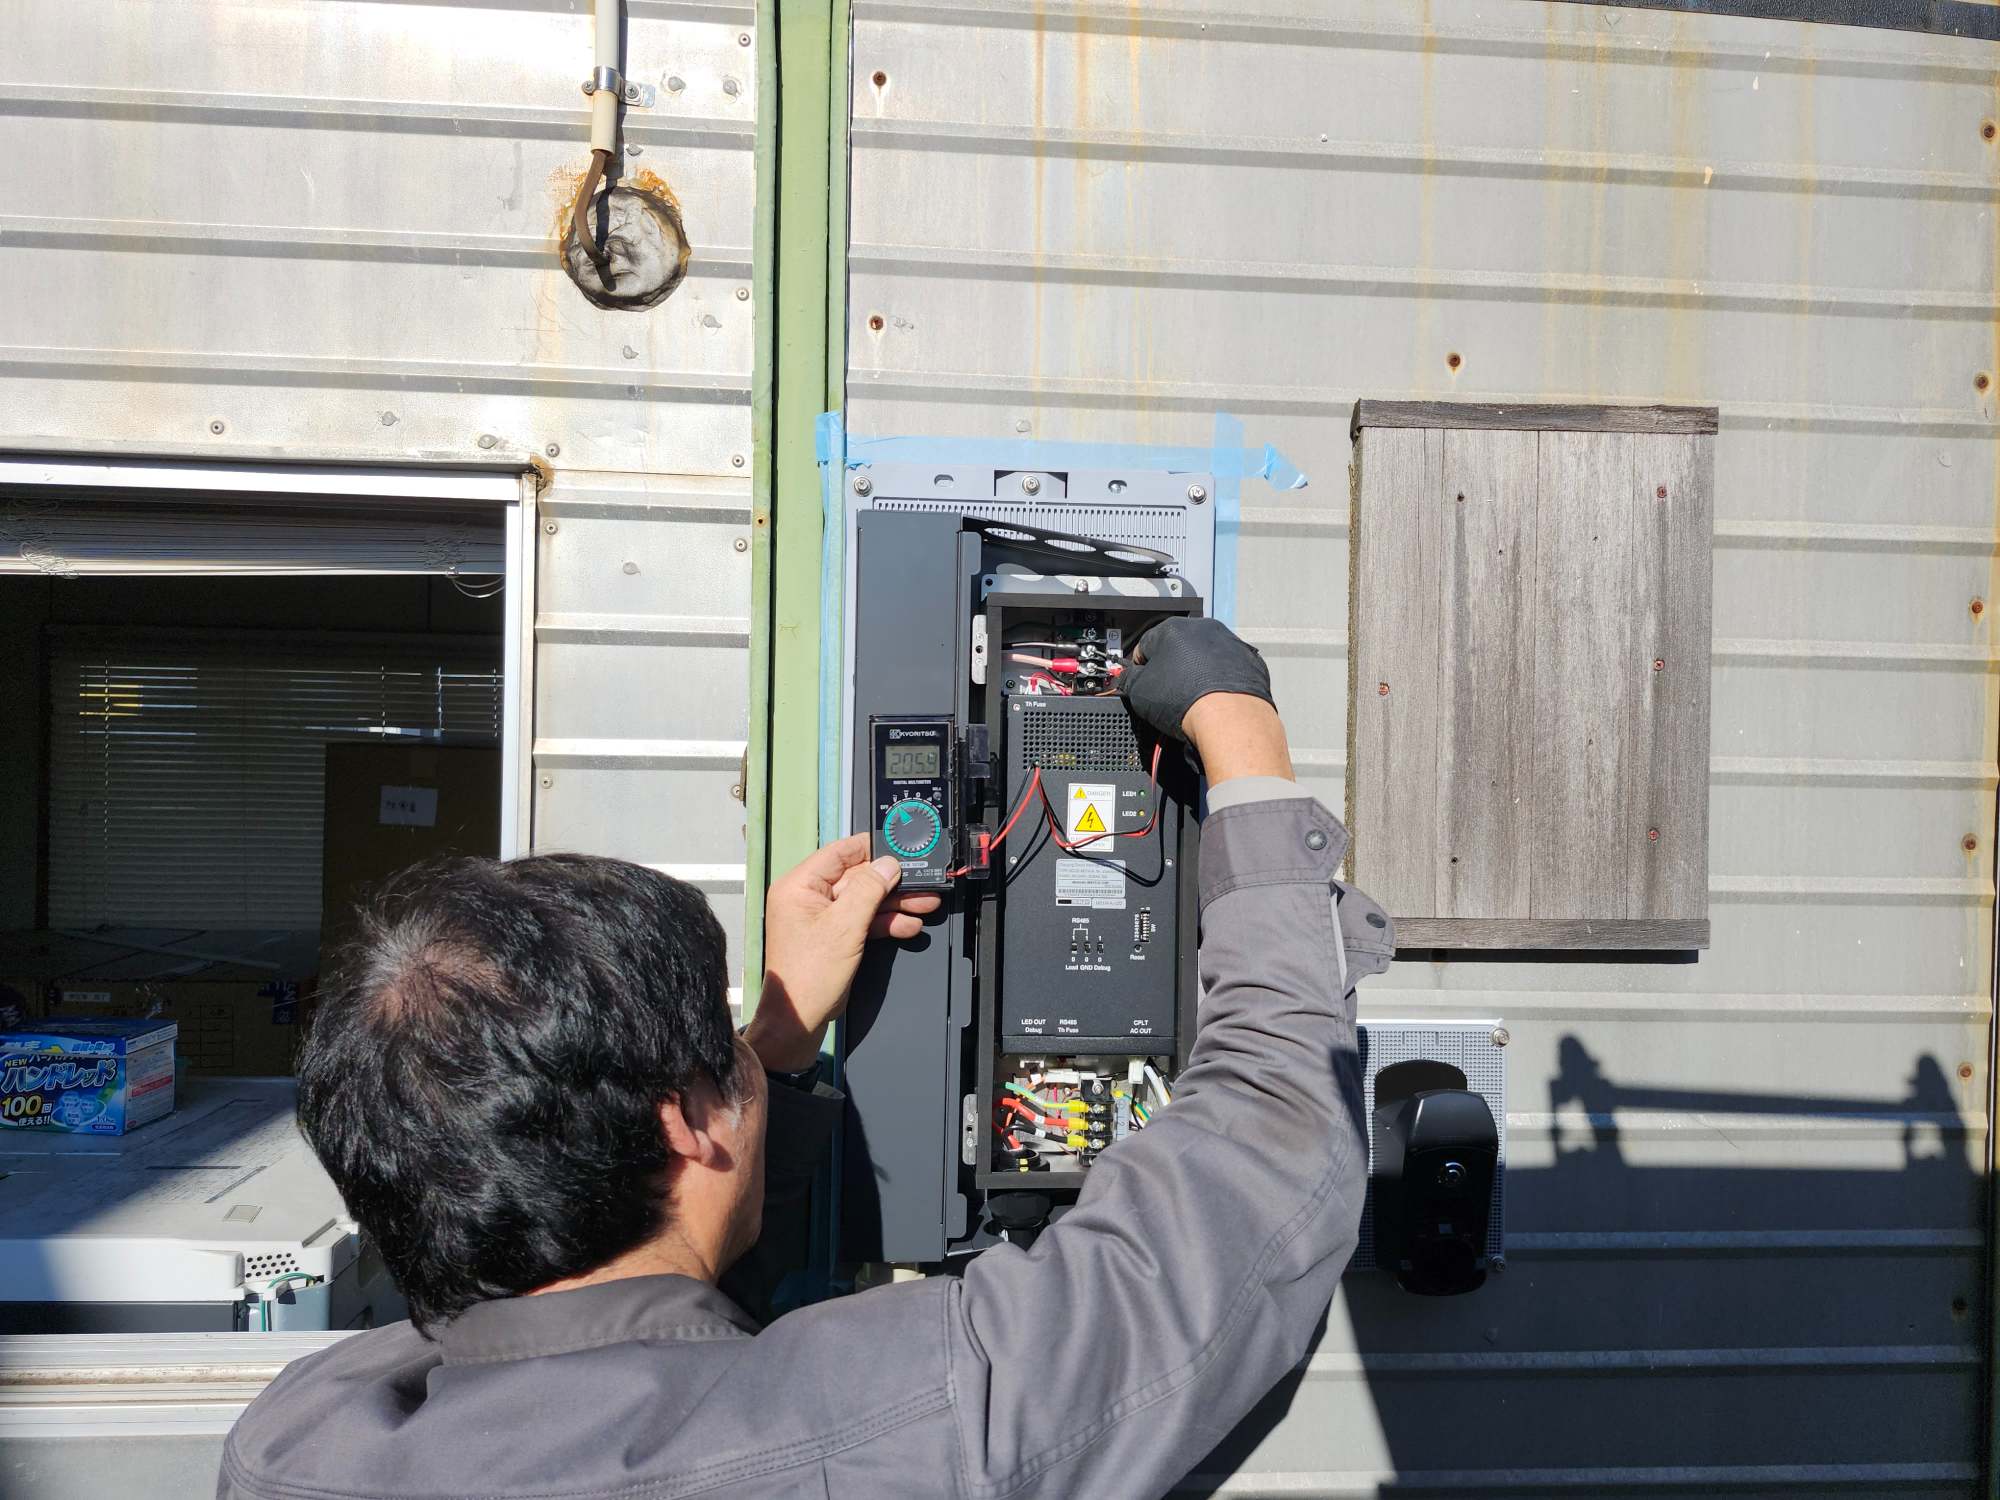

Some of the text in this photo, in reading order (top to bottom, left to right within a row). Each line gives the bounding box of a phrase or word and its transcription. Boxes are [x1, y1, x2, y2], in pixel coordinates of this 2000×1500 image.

[4, 1058, 28, 1068] NEW
[0, 1059, 117, 1093] ハンドレッド
